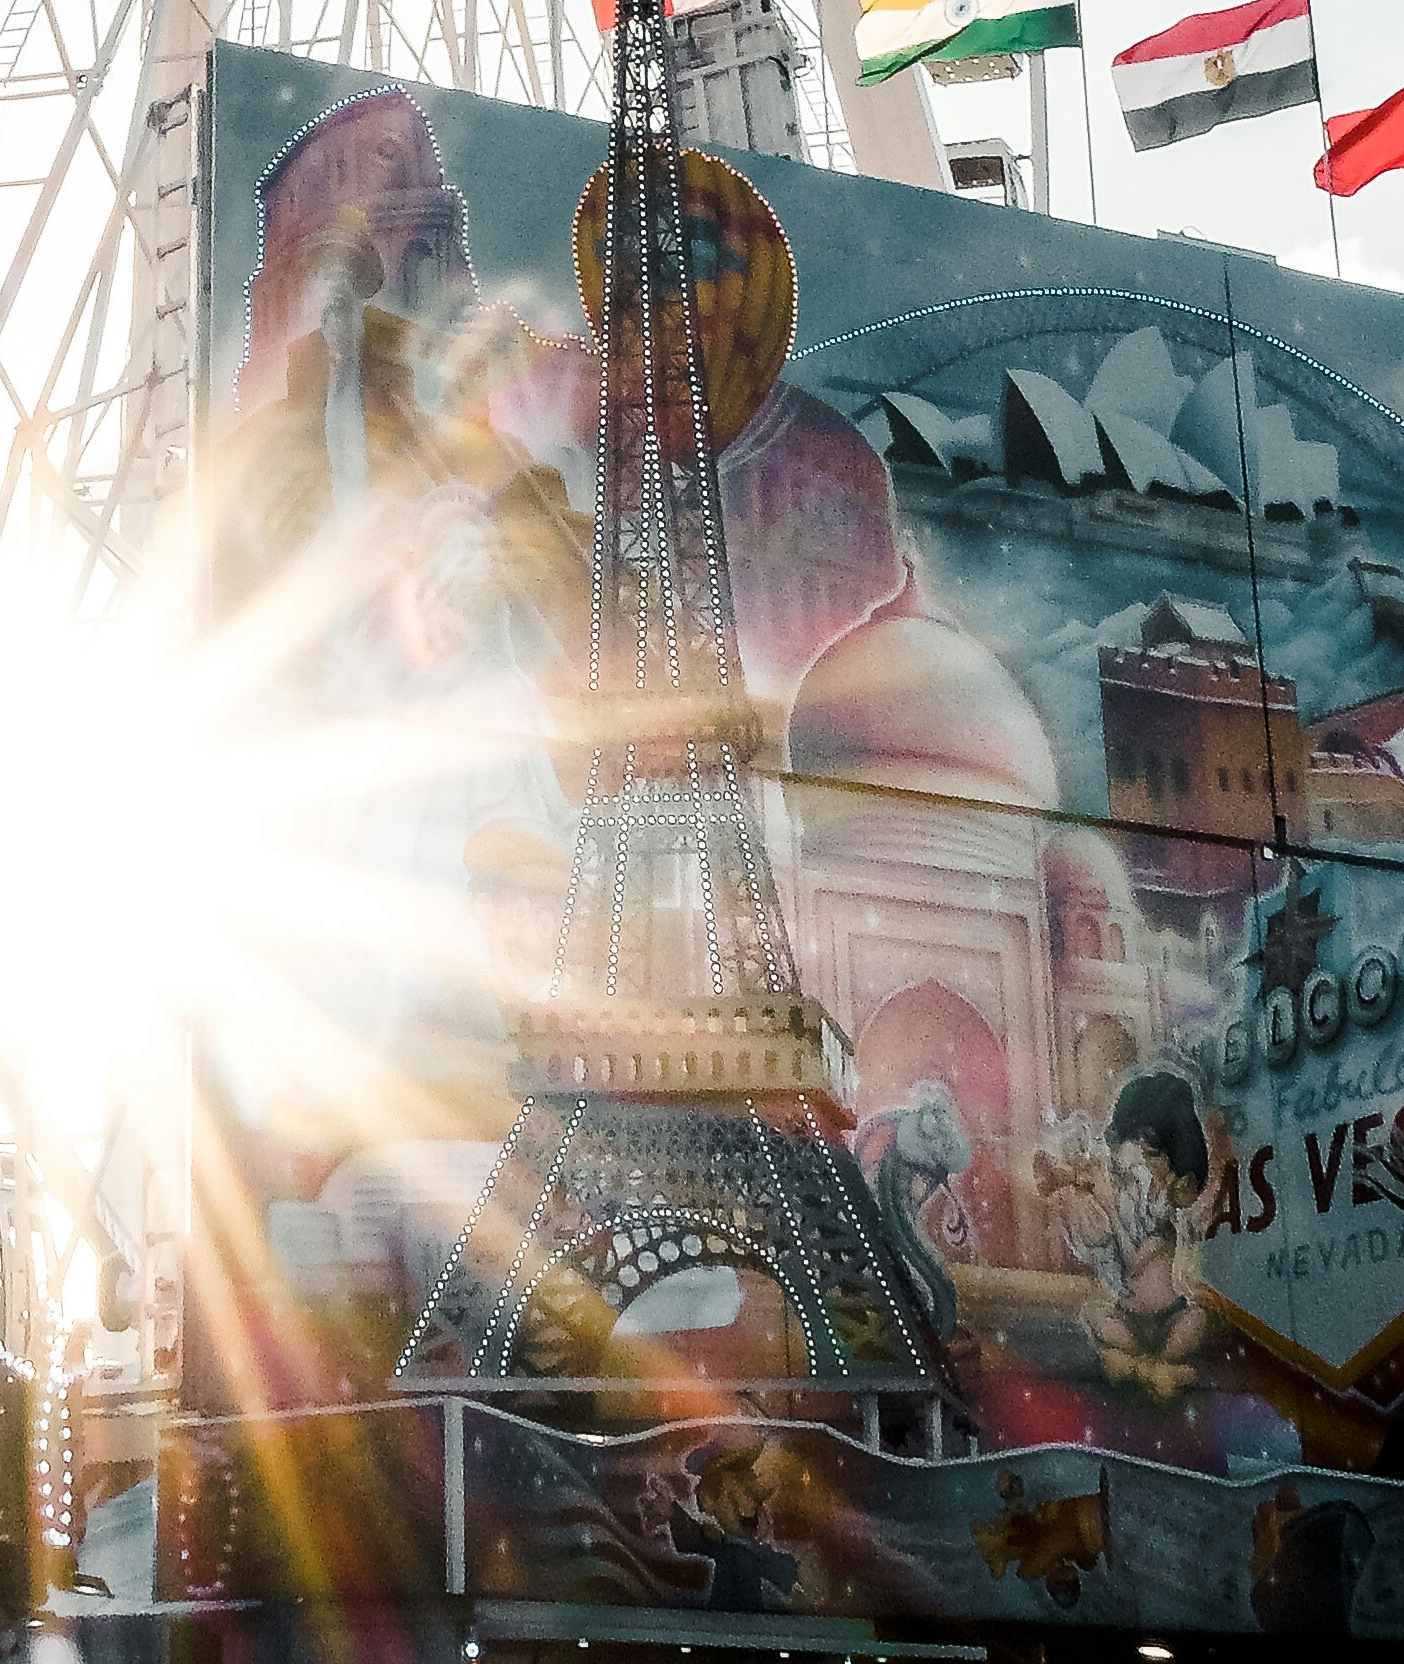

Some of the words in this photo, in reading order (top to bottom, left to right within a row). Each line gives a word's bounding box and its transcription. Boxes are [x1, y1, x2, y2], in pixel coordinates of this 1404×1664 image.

[1204, 1144, 1277, 1240] AS
[1304, 1112, 1385, 1215] VE
[1265, 1224, 1404, 1279] NEVAD
